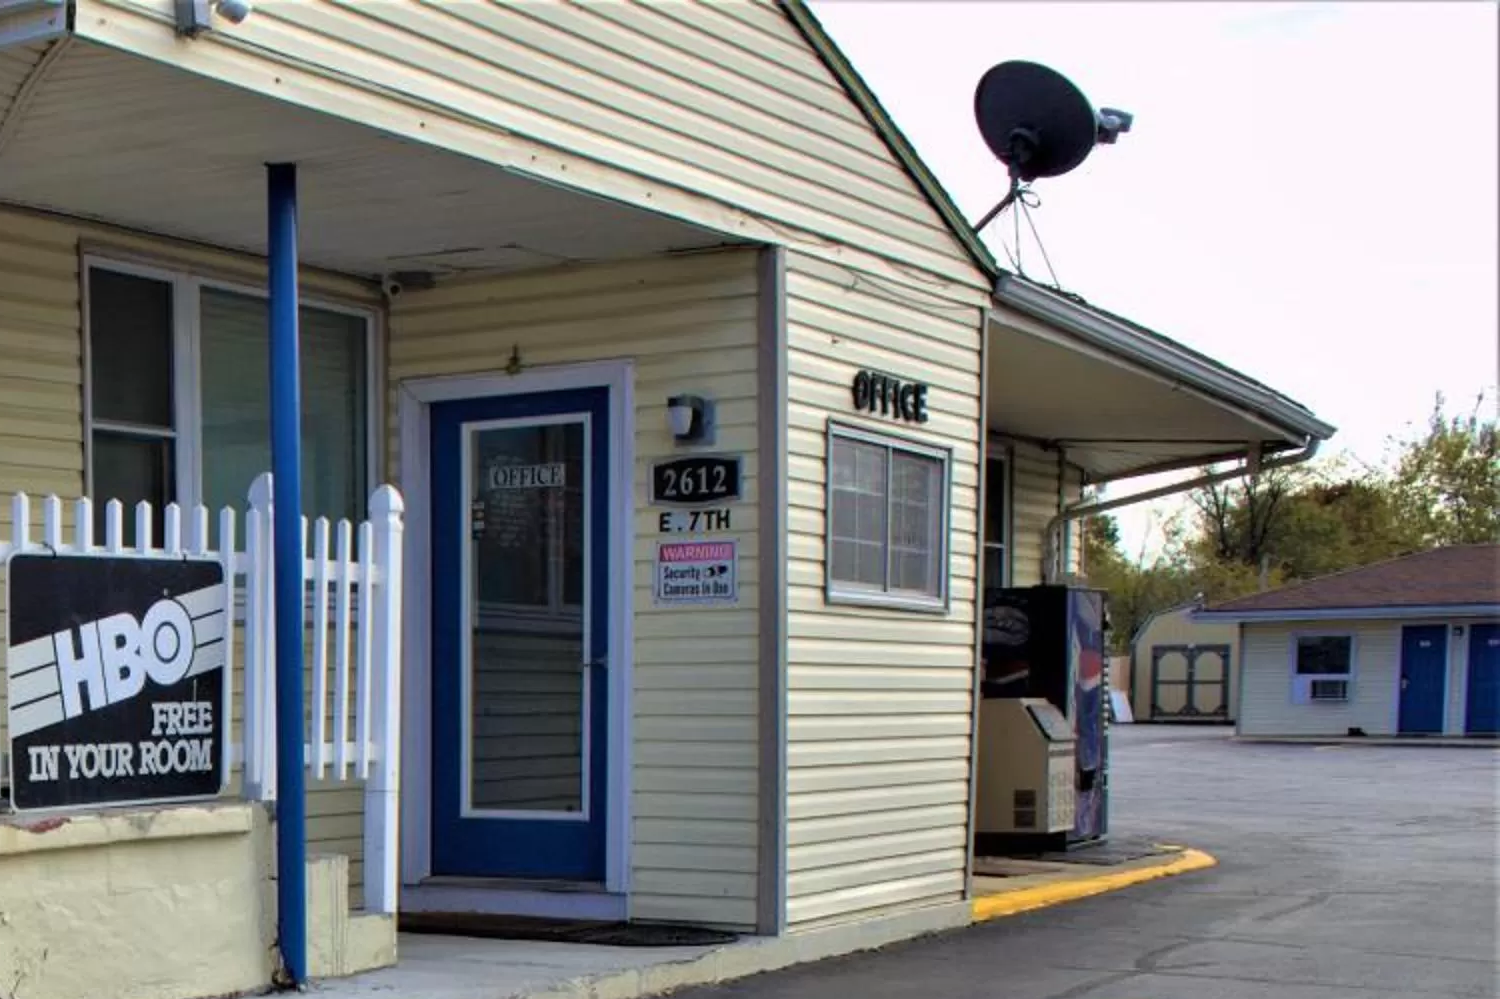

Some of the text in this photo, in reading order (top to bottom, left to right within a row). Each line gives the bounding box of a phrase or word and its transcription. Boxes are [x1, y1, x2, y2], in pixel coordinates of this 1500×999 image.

[852, 370, 928, 423] OFFICE
[493, 465, 561, 486] OFFICE
[663, 465, 728, 497] 2612
[662, 544, 729, 561] WARNING
[663, 566, 701, 581] Security
[663, 582, 700, 595] Cameras
[53, 598, 195, 721] HBO
[151, 701, 213, 736] FREE
[28, 737, 213, 782] IN YOUR ROOM
